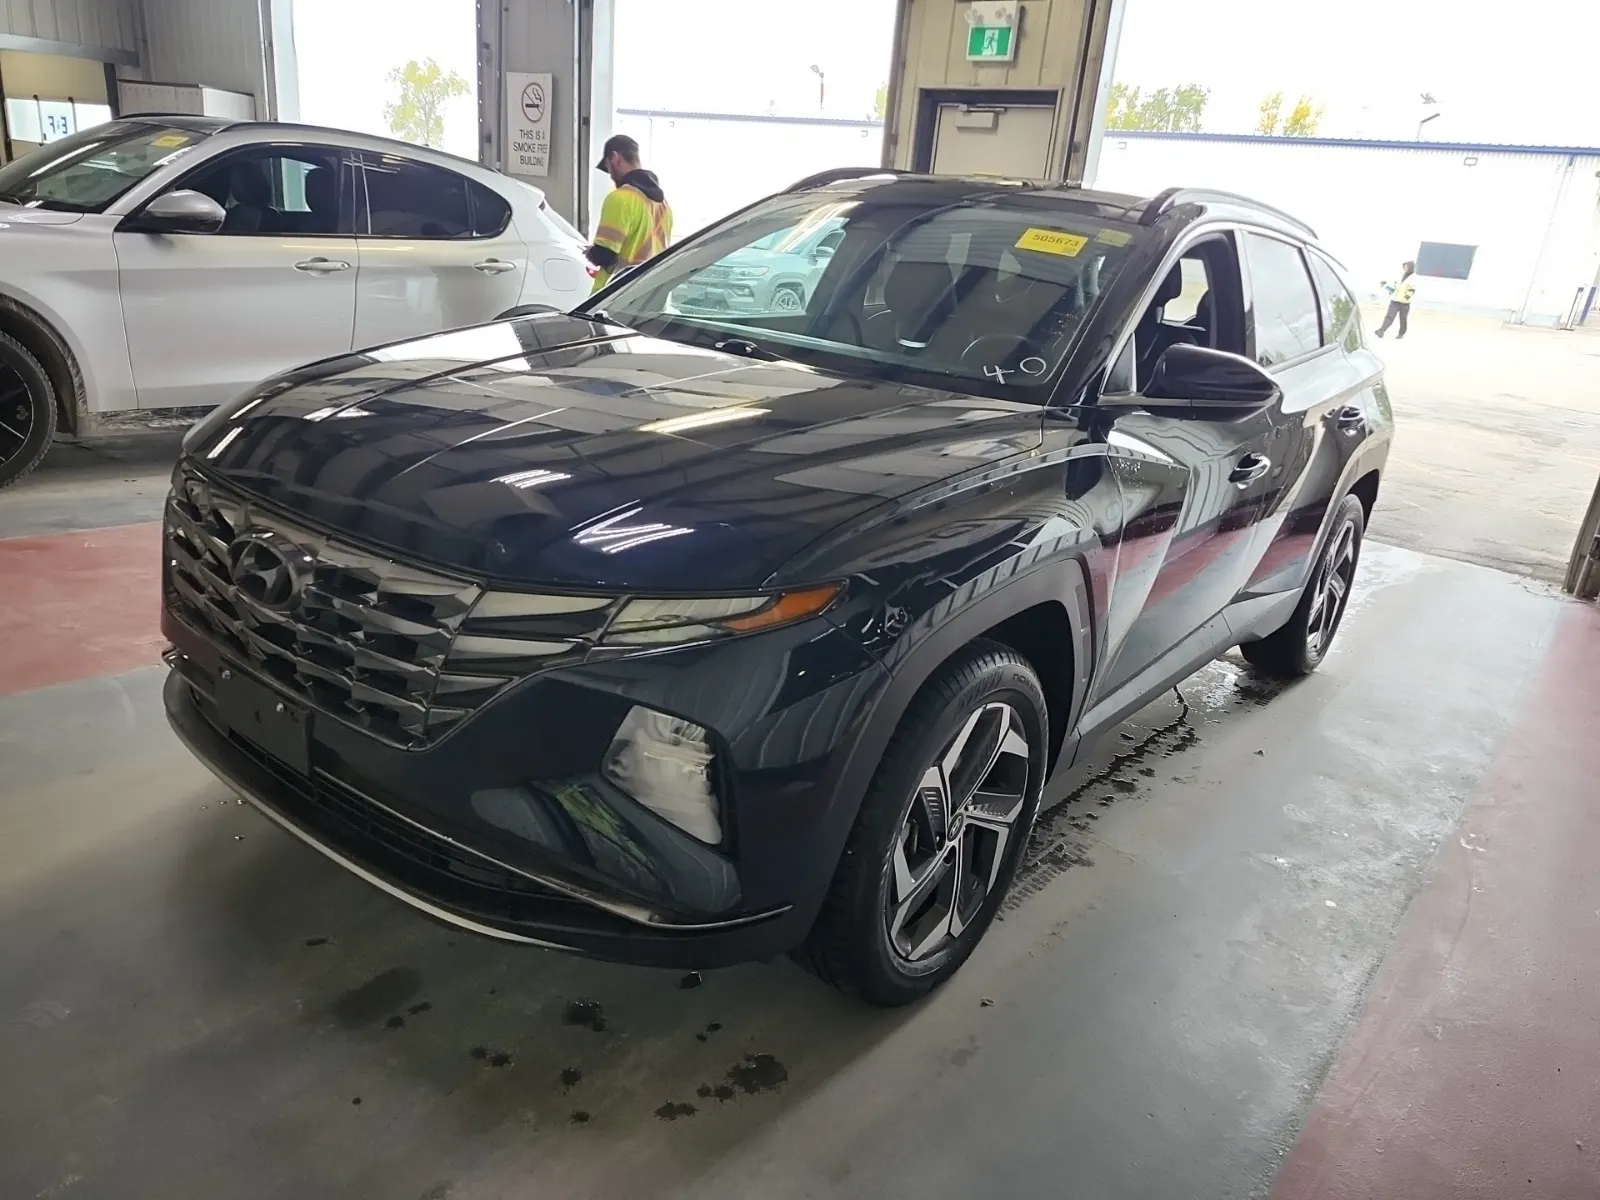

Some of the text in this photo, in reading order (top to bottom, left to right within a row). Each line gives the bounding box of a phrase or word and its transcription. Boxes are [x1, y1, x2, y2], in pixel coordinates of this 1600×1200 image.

[519, 129, 534, 140] THIS
[535, 130, 541, 141] IS
[513, 141, 548, 154] SMOKE FREE
[520, 155, 544, 167] BUILDING
[1032, 234, 1080, 247] 505673
